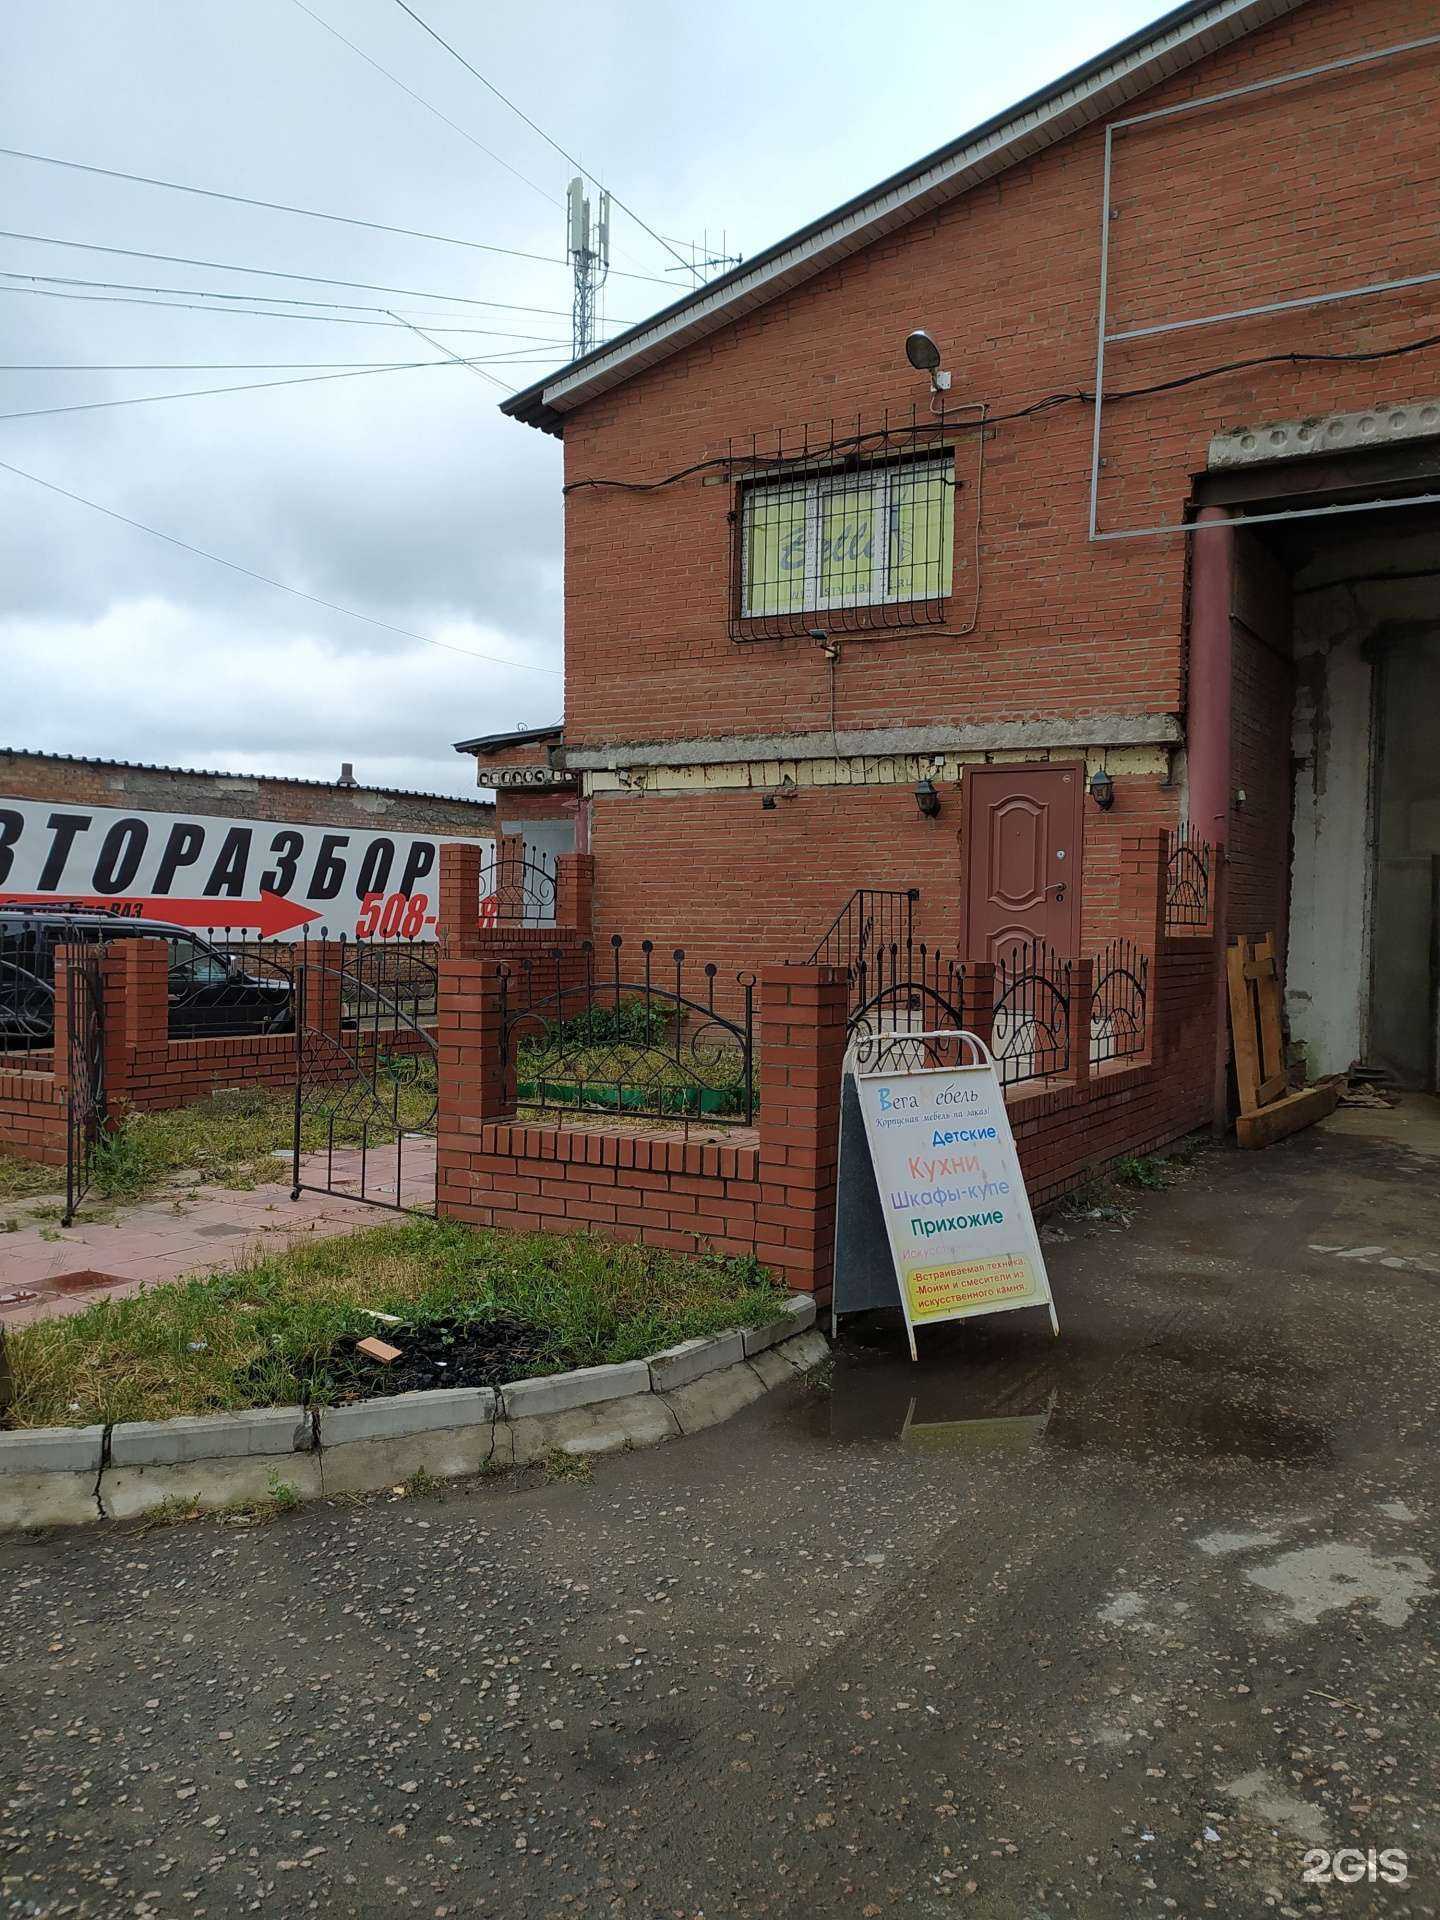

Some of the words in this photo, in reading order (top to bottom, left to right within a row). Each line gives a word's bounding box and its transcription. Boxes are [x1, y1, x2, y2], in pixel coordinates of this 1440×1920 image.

[878, 1088, 920, 1111] Вега
[932, 1126, 997, 1146] Детские
[908, 1156, 980, 1182] Кухни
[891, 1180, 1010, 1209] Шкафы-купе
[911, 1209, 1004, 1237] Прихожие
[1013, 1270, 1024, 1279] из
[918, 1288, 994, 1308] искусственного
